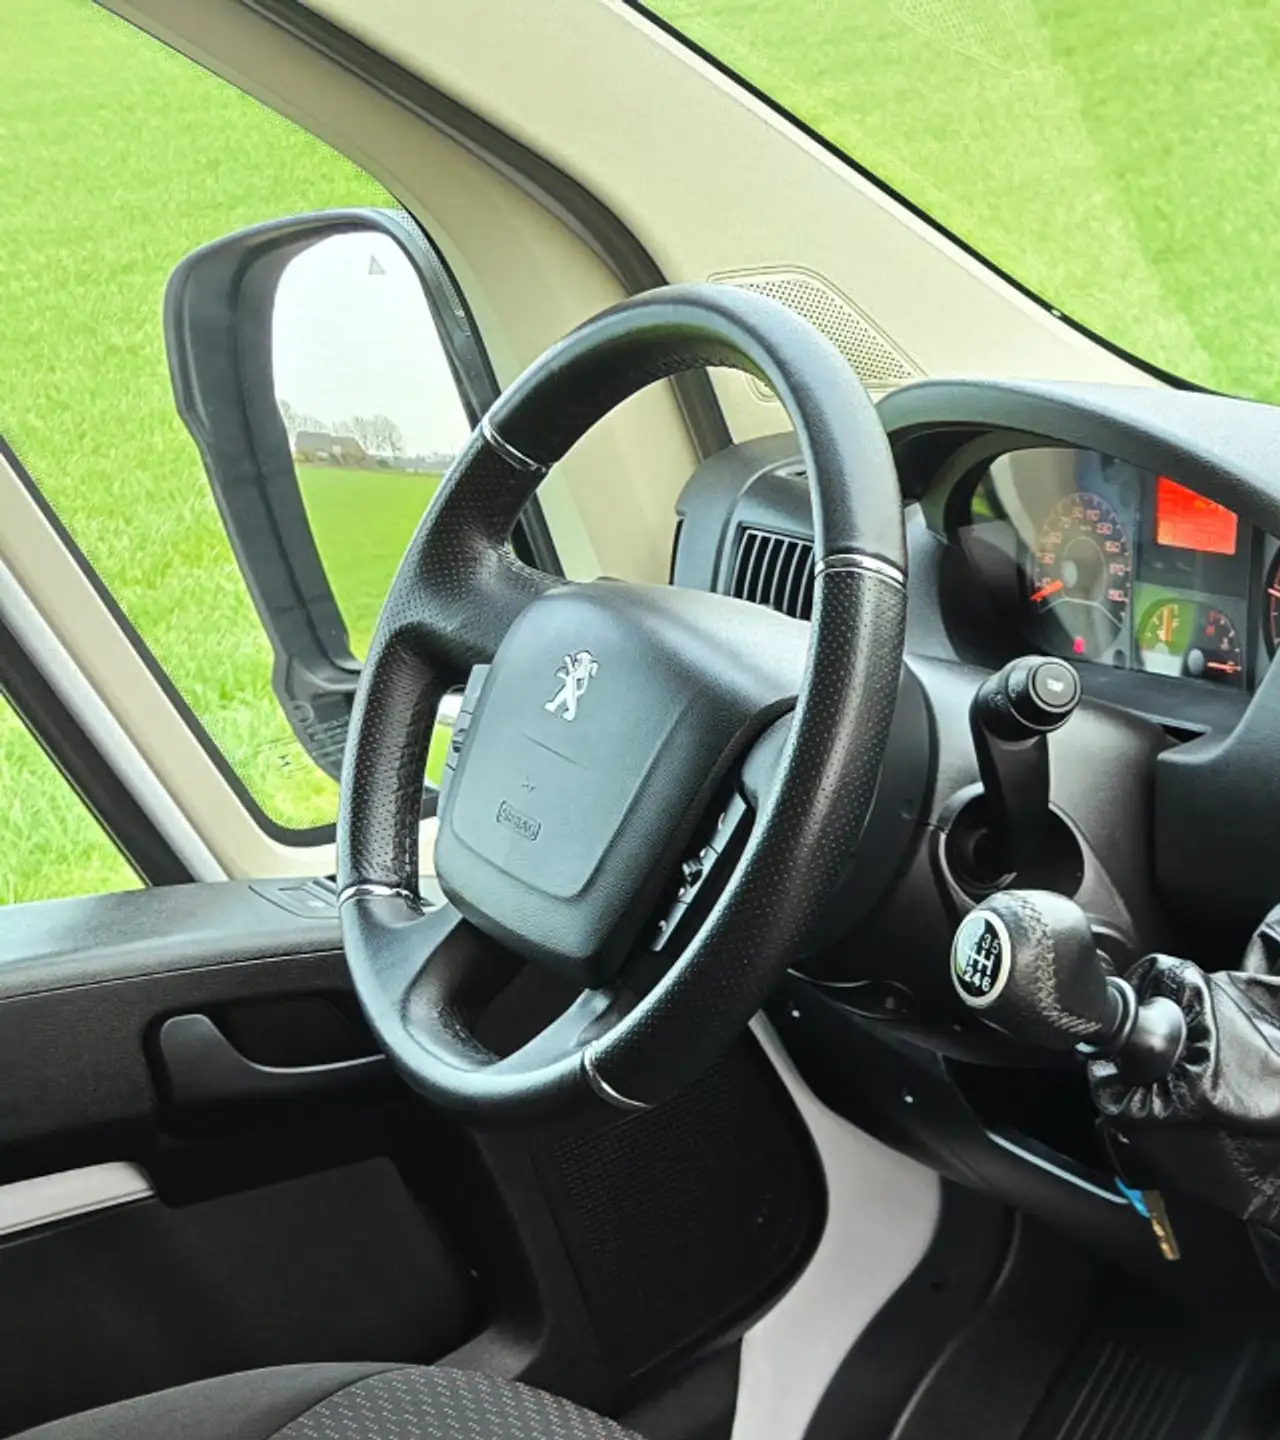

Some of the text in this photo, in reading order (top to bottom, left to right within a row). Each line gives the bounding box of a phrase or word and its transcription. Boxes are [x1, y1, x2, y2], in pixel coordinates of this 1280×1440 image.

[982, 933, 1001, 955] 3 5
[962, 964, 975, 982] 2
[981, 975, 992, 992] 6
